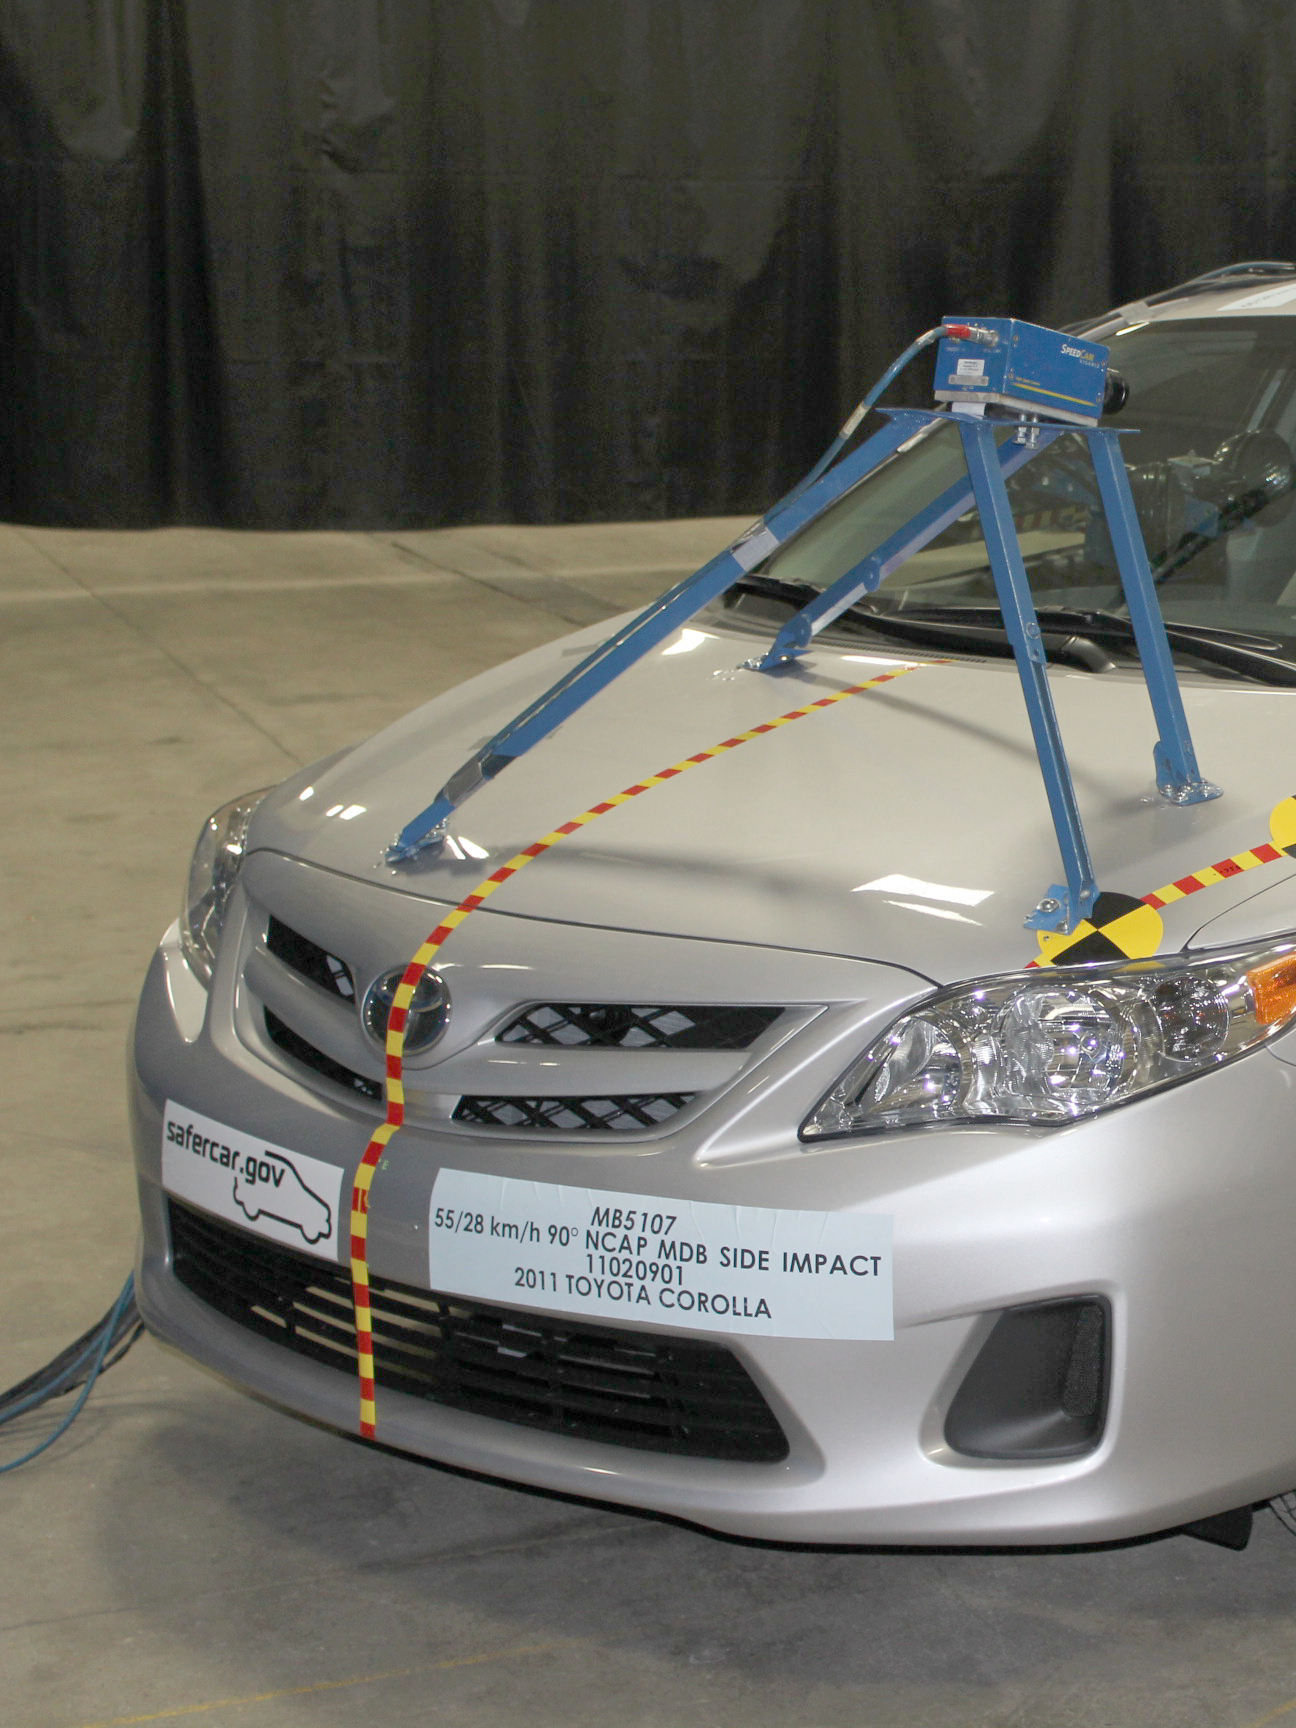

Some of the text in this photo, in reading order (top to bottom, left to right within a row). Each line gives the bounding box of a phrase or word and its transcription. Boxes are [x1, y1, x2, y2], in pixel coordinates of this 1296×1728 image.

[166, 1120, 286, 1188] safercar.gov
[434, 1207, 484, 1234] 55/28
[490, 1215, 541, 1244] km/h
[585, 1229, 648, 1257] NCAP
[657, 1239, 708, 1265] MDB
[719, 1246, 770, 1272] SIDE
[782, 1251, 882, 1277] IMPACT
[590, 1206, 677, 1236] MB5107
[514, 1266, 772, 1319] 2011 TOYOTA COROLLA
[586, 1253, 683, 1286] 11020901
